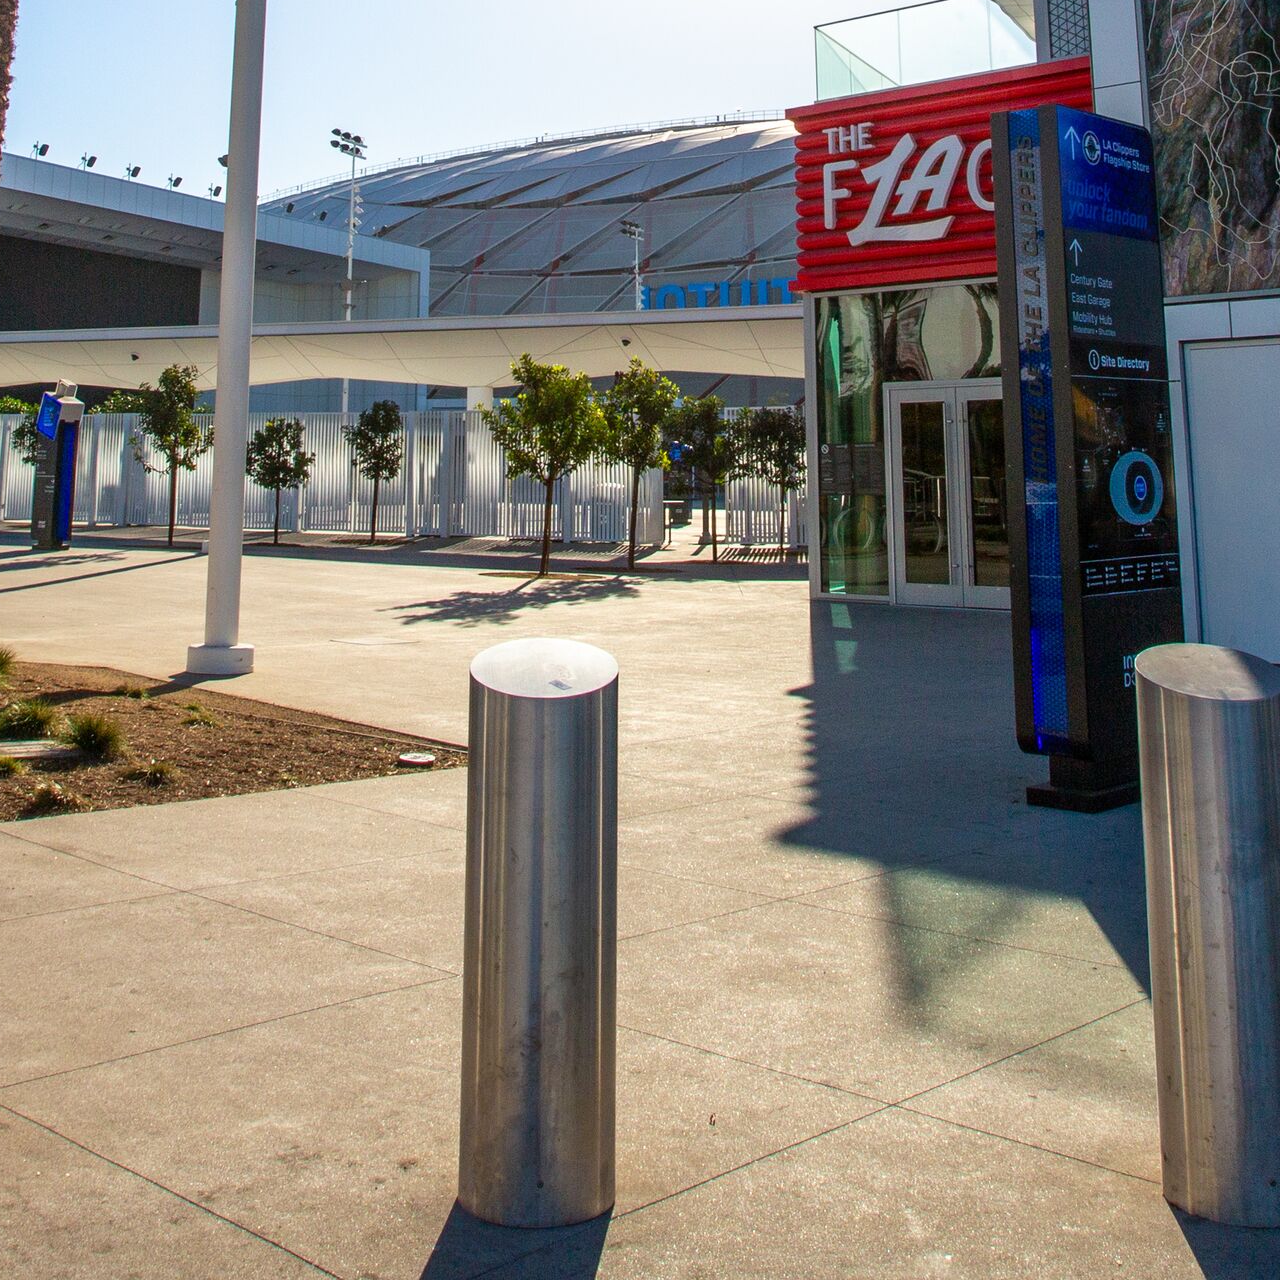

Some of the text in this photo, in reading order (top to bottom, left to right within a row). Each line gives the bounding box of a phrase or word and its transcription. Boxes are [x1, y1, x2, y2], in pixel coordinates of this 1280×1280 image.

[822, 122, 875, 154] THE
[1103, 140, 1140, 158] LA Clippers
[1103, 153, 1150, 174] Flagship Store
[1017, 135, 1039, 258] CLIPPERS
[1067, 179, 1110, 201] unlock
[1068, 199, 1148, 229] your fandom
[1022, 266, 1042, 297] LA
[1070, 273, 1113, 289] Century Gate
[1071, 292, 1111, 308] East Garage
[1025, 303, 1043, 352] THE
[1101, 355, 1150, 372] Site Directory
[1031, 404, 1049, 484] HOME
